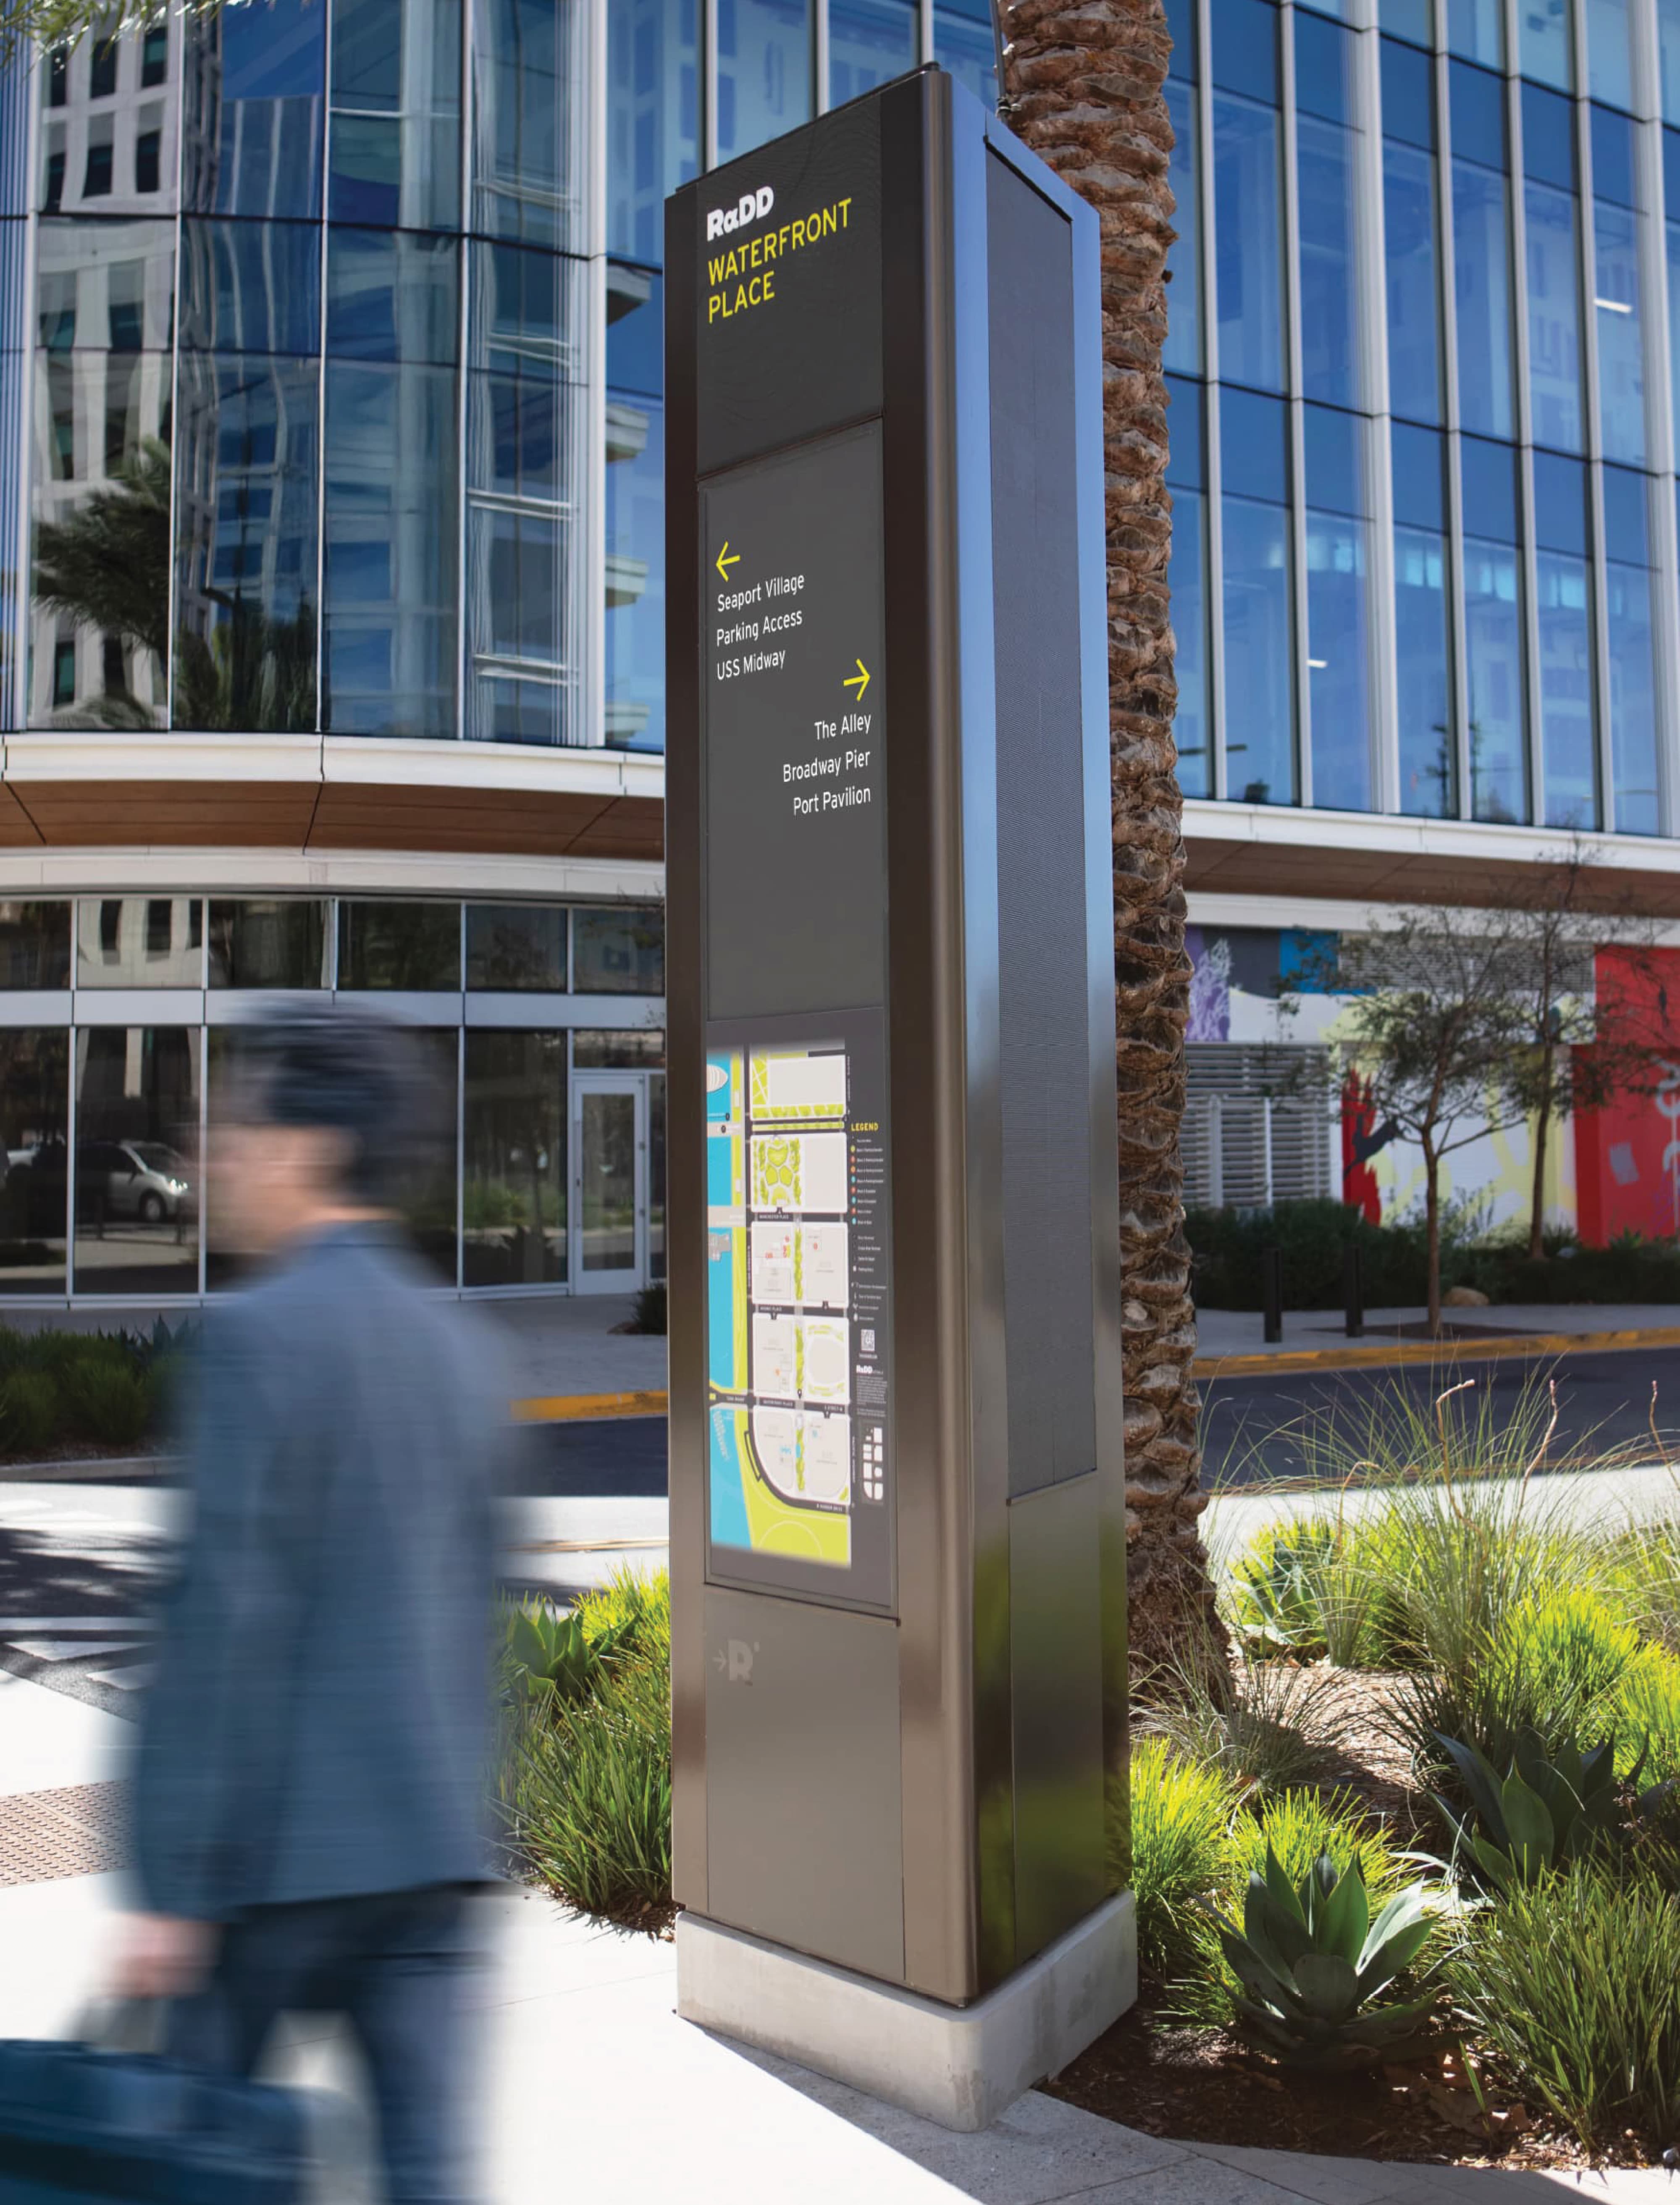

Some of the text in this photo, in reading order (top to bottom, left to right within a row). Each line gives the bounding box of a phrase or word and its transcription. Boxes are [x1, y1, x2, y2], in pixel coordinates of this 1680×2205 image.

[707, 186, 774, 242] RaDD
[708, 198, 852, 286] WATERFRONT
[709, 270, 775, 324] PLACE
[717, 574, 805, 612] Seaport Village
[717, 610, 803, 647] Parking Access
[717, 649, 786, 681] USS Midway
[814, 713, 872, 740] The Alley
[782, 748, 871, 782] Broadway Pier
[793, 785, 871, 816] Port Pavilion
[851, 1122, 879, 1131] LEGEND
